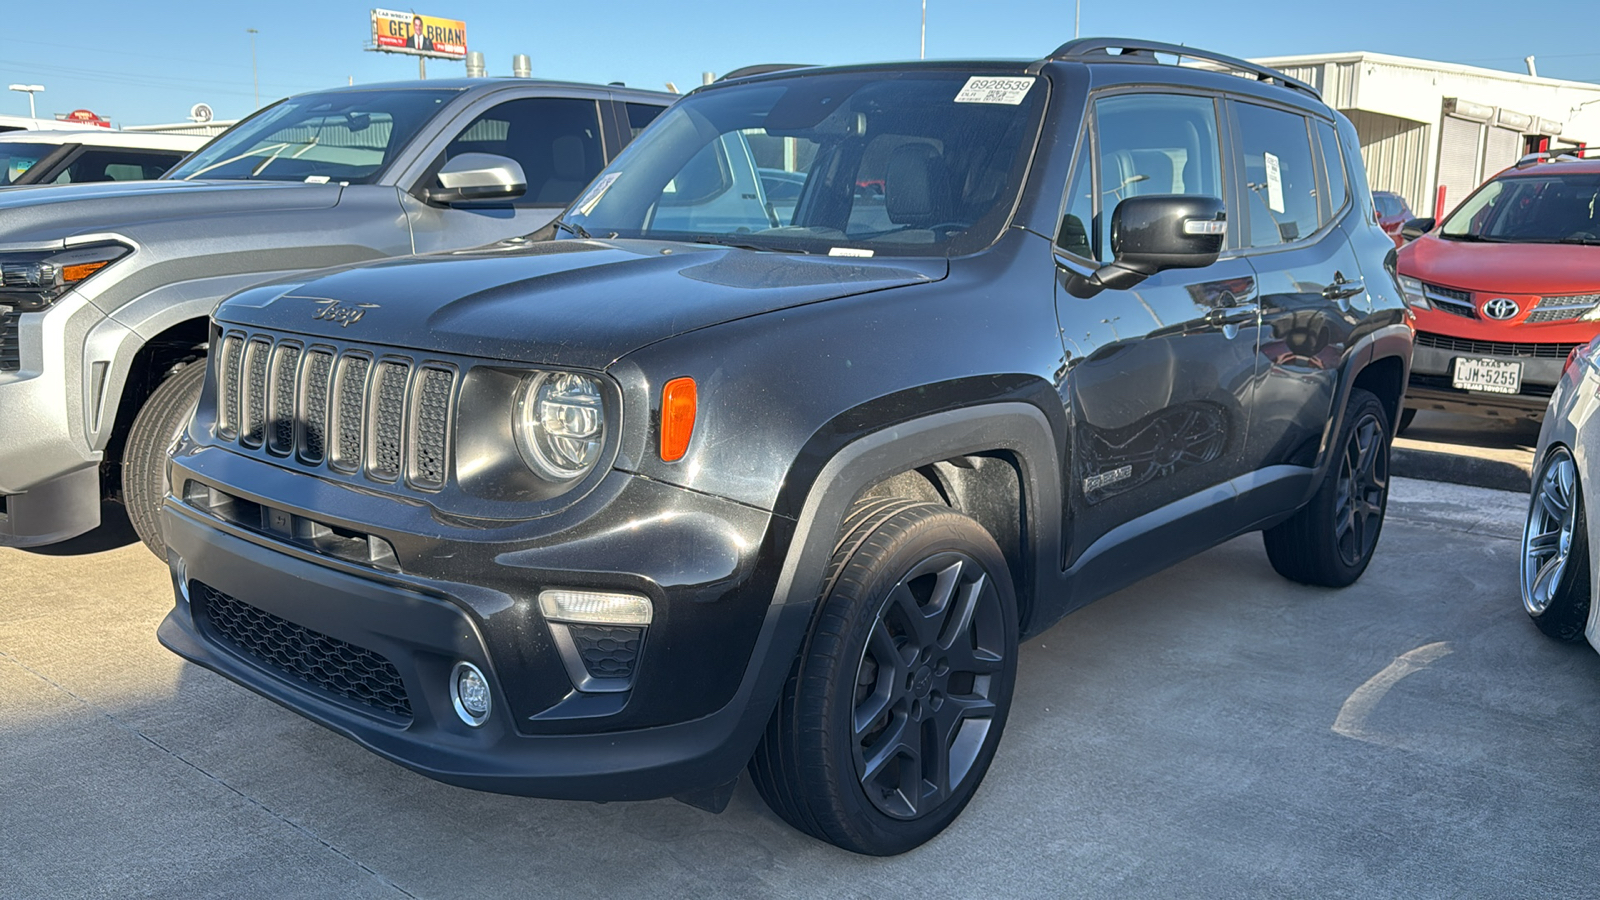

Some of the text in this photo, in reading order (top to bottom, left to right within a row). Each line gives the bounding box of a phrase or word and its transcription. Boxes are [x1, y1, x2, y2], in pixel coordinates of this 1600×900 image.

[389, 20, 465, 46] GET BRIAN!
[970, 80, 1030, 91] 6928539
[312, 300, 366, 328] Jeep
[1476, 360, 1501, 368] TEXAS
